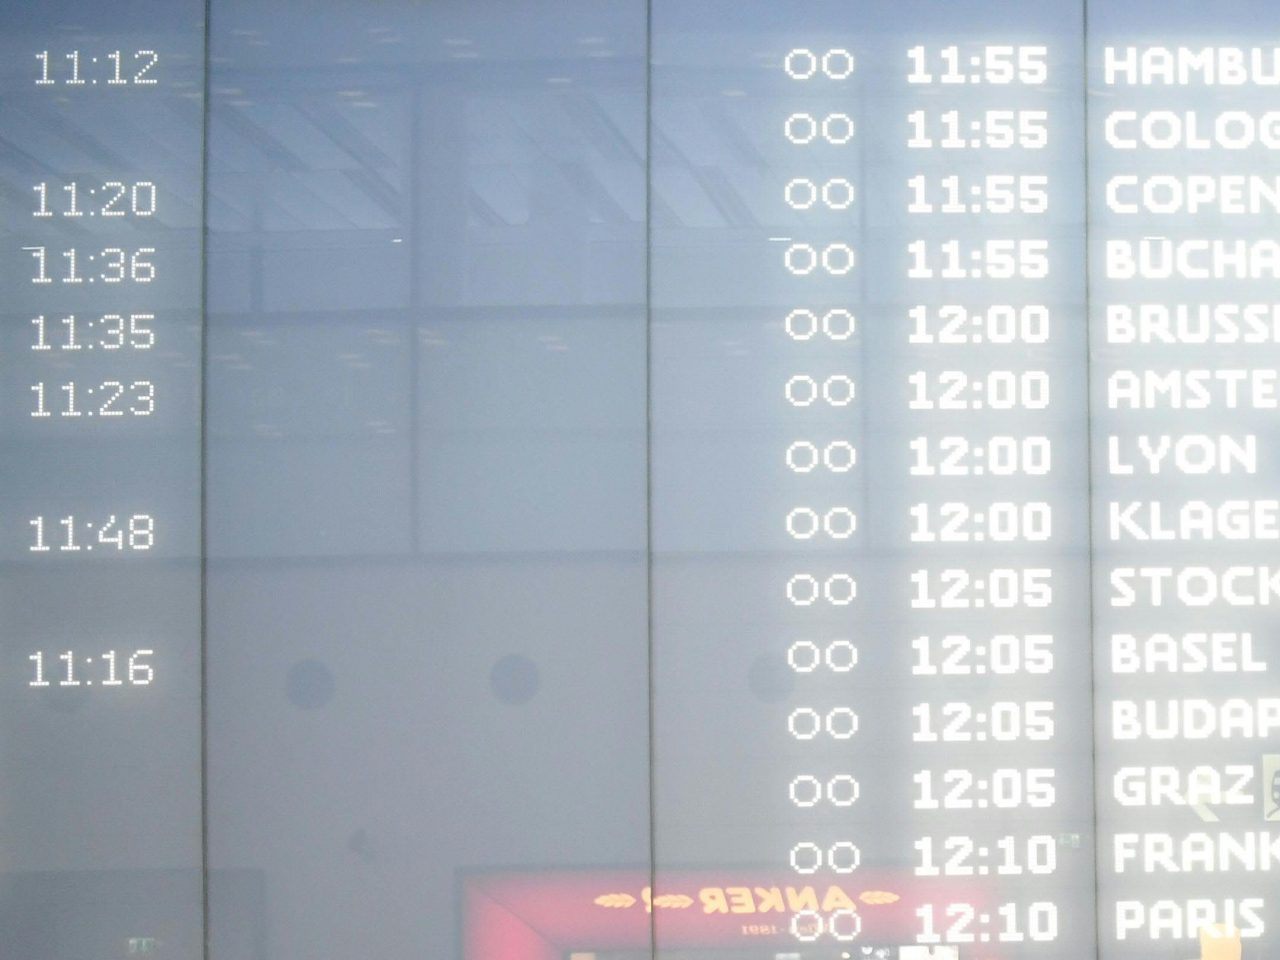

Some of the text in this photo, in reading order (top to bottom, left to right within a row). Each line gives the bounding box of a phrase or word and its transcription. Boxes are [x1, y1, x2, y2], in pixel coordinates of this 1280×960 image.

[36, 51, 157, 83] 11:12
[909, 46, 1046, 83] 11:55
[909, 111, 1047, 148] 11:55
[34, 182, 155, 215] 11:20
[909, 176, 1047, 213] 11:55
[33, 248, 154, 282] 11:36
[909, 240, 1048, 278] 11:55
[32, 315, 154, 349] 11:35
[910, 306, 1048, 343] 12:00
[32, 382, 153, 416] 11:23
[910, 371, 1049, 409] 12:00
[911, 437, 1050, 475] 12:00
[1109, 435, 1256, 473] LYON
[31, 515, 153, 550] 11:48
[911, 503, 1051, 541] 12:00
[912, 569, 1051, 608] 12:05
[30, 650, 153, 685] 11:16
[913, 635, 1053, 674] 12:05
[1112, 633, 1266, 672] BASEL
[913, 702, 1053, 741] 12:05
[914, 769, 1055, 808] 12:05
[1114, 766, 1253, 805] GRAZ
[915, 836, 1056, 875] 12:10
[916, 902, 1057, 943] 12:10
[1117, 899, 1264, 939] PARIS
